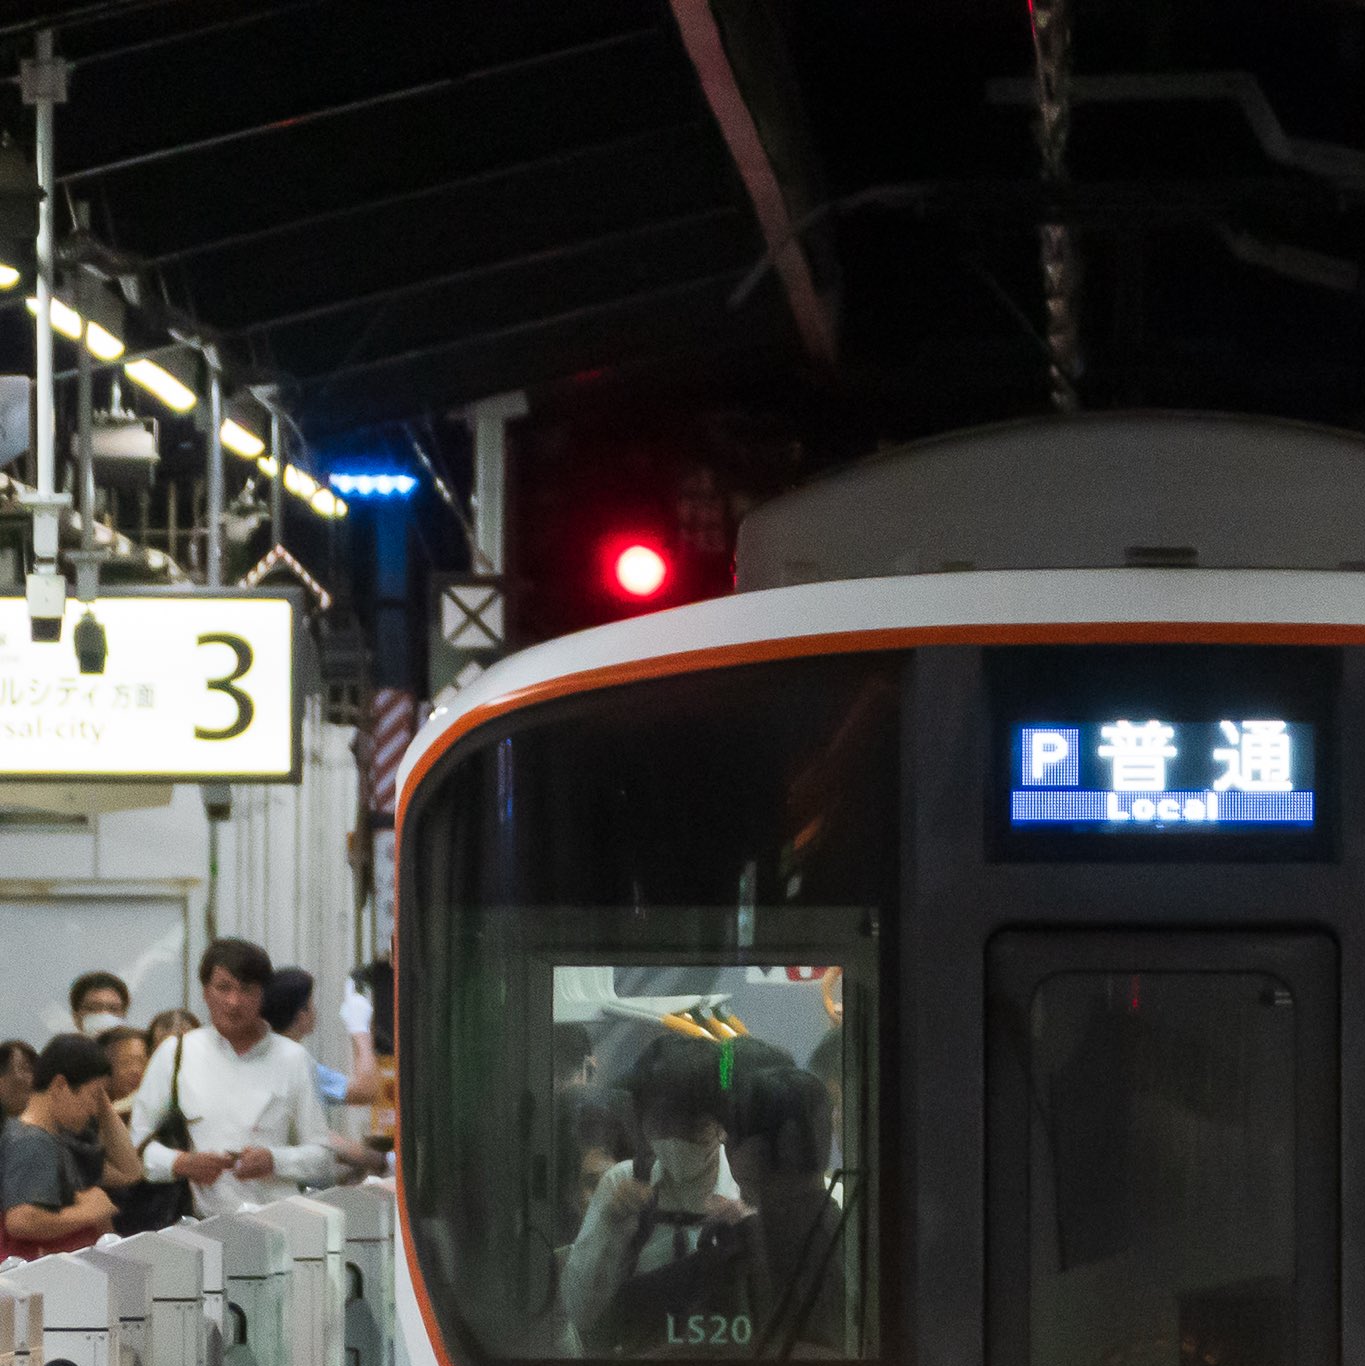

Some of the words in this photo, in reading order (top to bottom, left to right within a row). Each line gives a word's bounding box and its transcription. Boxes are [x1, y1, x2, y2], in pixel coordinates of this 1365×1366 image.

[193, 631, 256, 742] 3
[1097, 719, 1294, 793] 普通
[1105, 790, 1220, 822] Local
[665, 1312, 751, 1346] LS20
